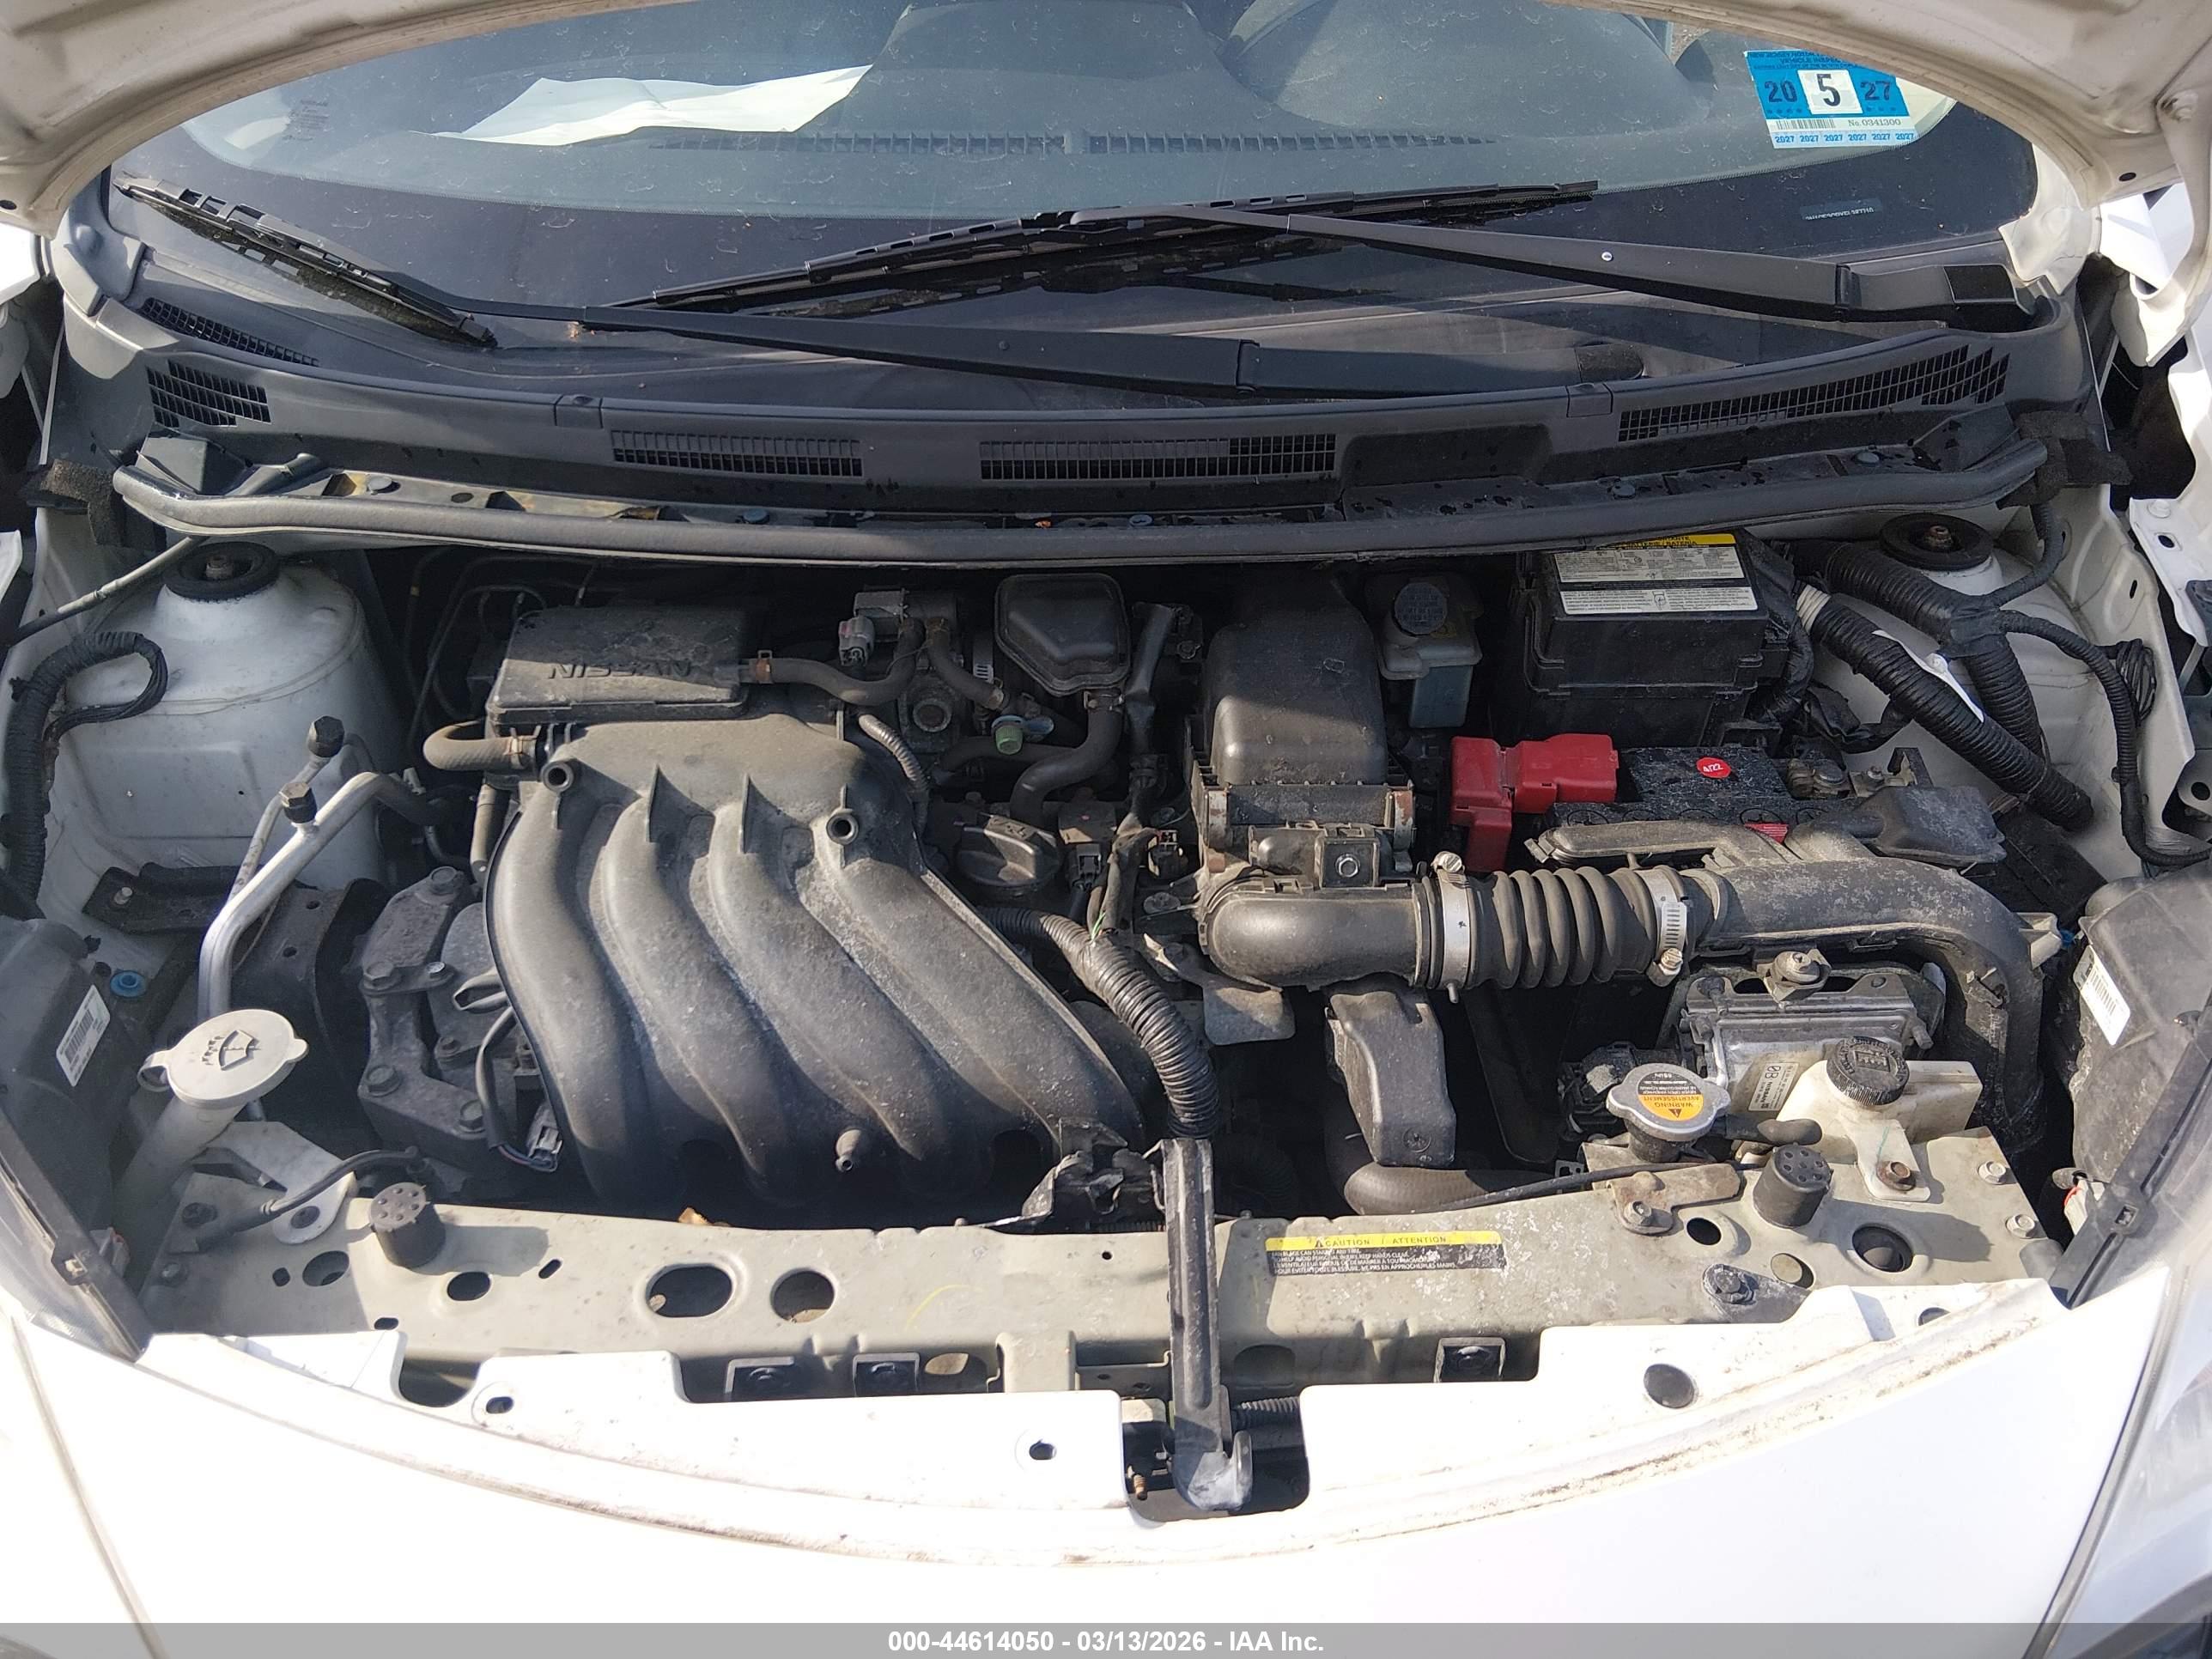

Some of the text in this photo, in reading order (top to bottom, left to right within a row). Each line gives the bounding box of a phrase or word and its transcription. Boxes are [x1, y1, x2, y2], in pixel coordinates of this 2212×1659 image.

[1765, 74, 1890, 106] 20 5 27
[1848, 118, 1861, 127] No.
[548, 661, 691, 679] NISSAN
[1760, 1082, 1772, 1103] NISSAN
[1325, 1238, 1370, 1247] CAUTION
